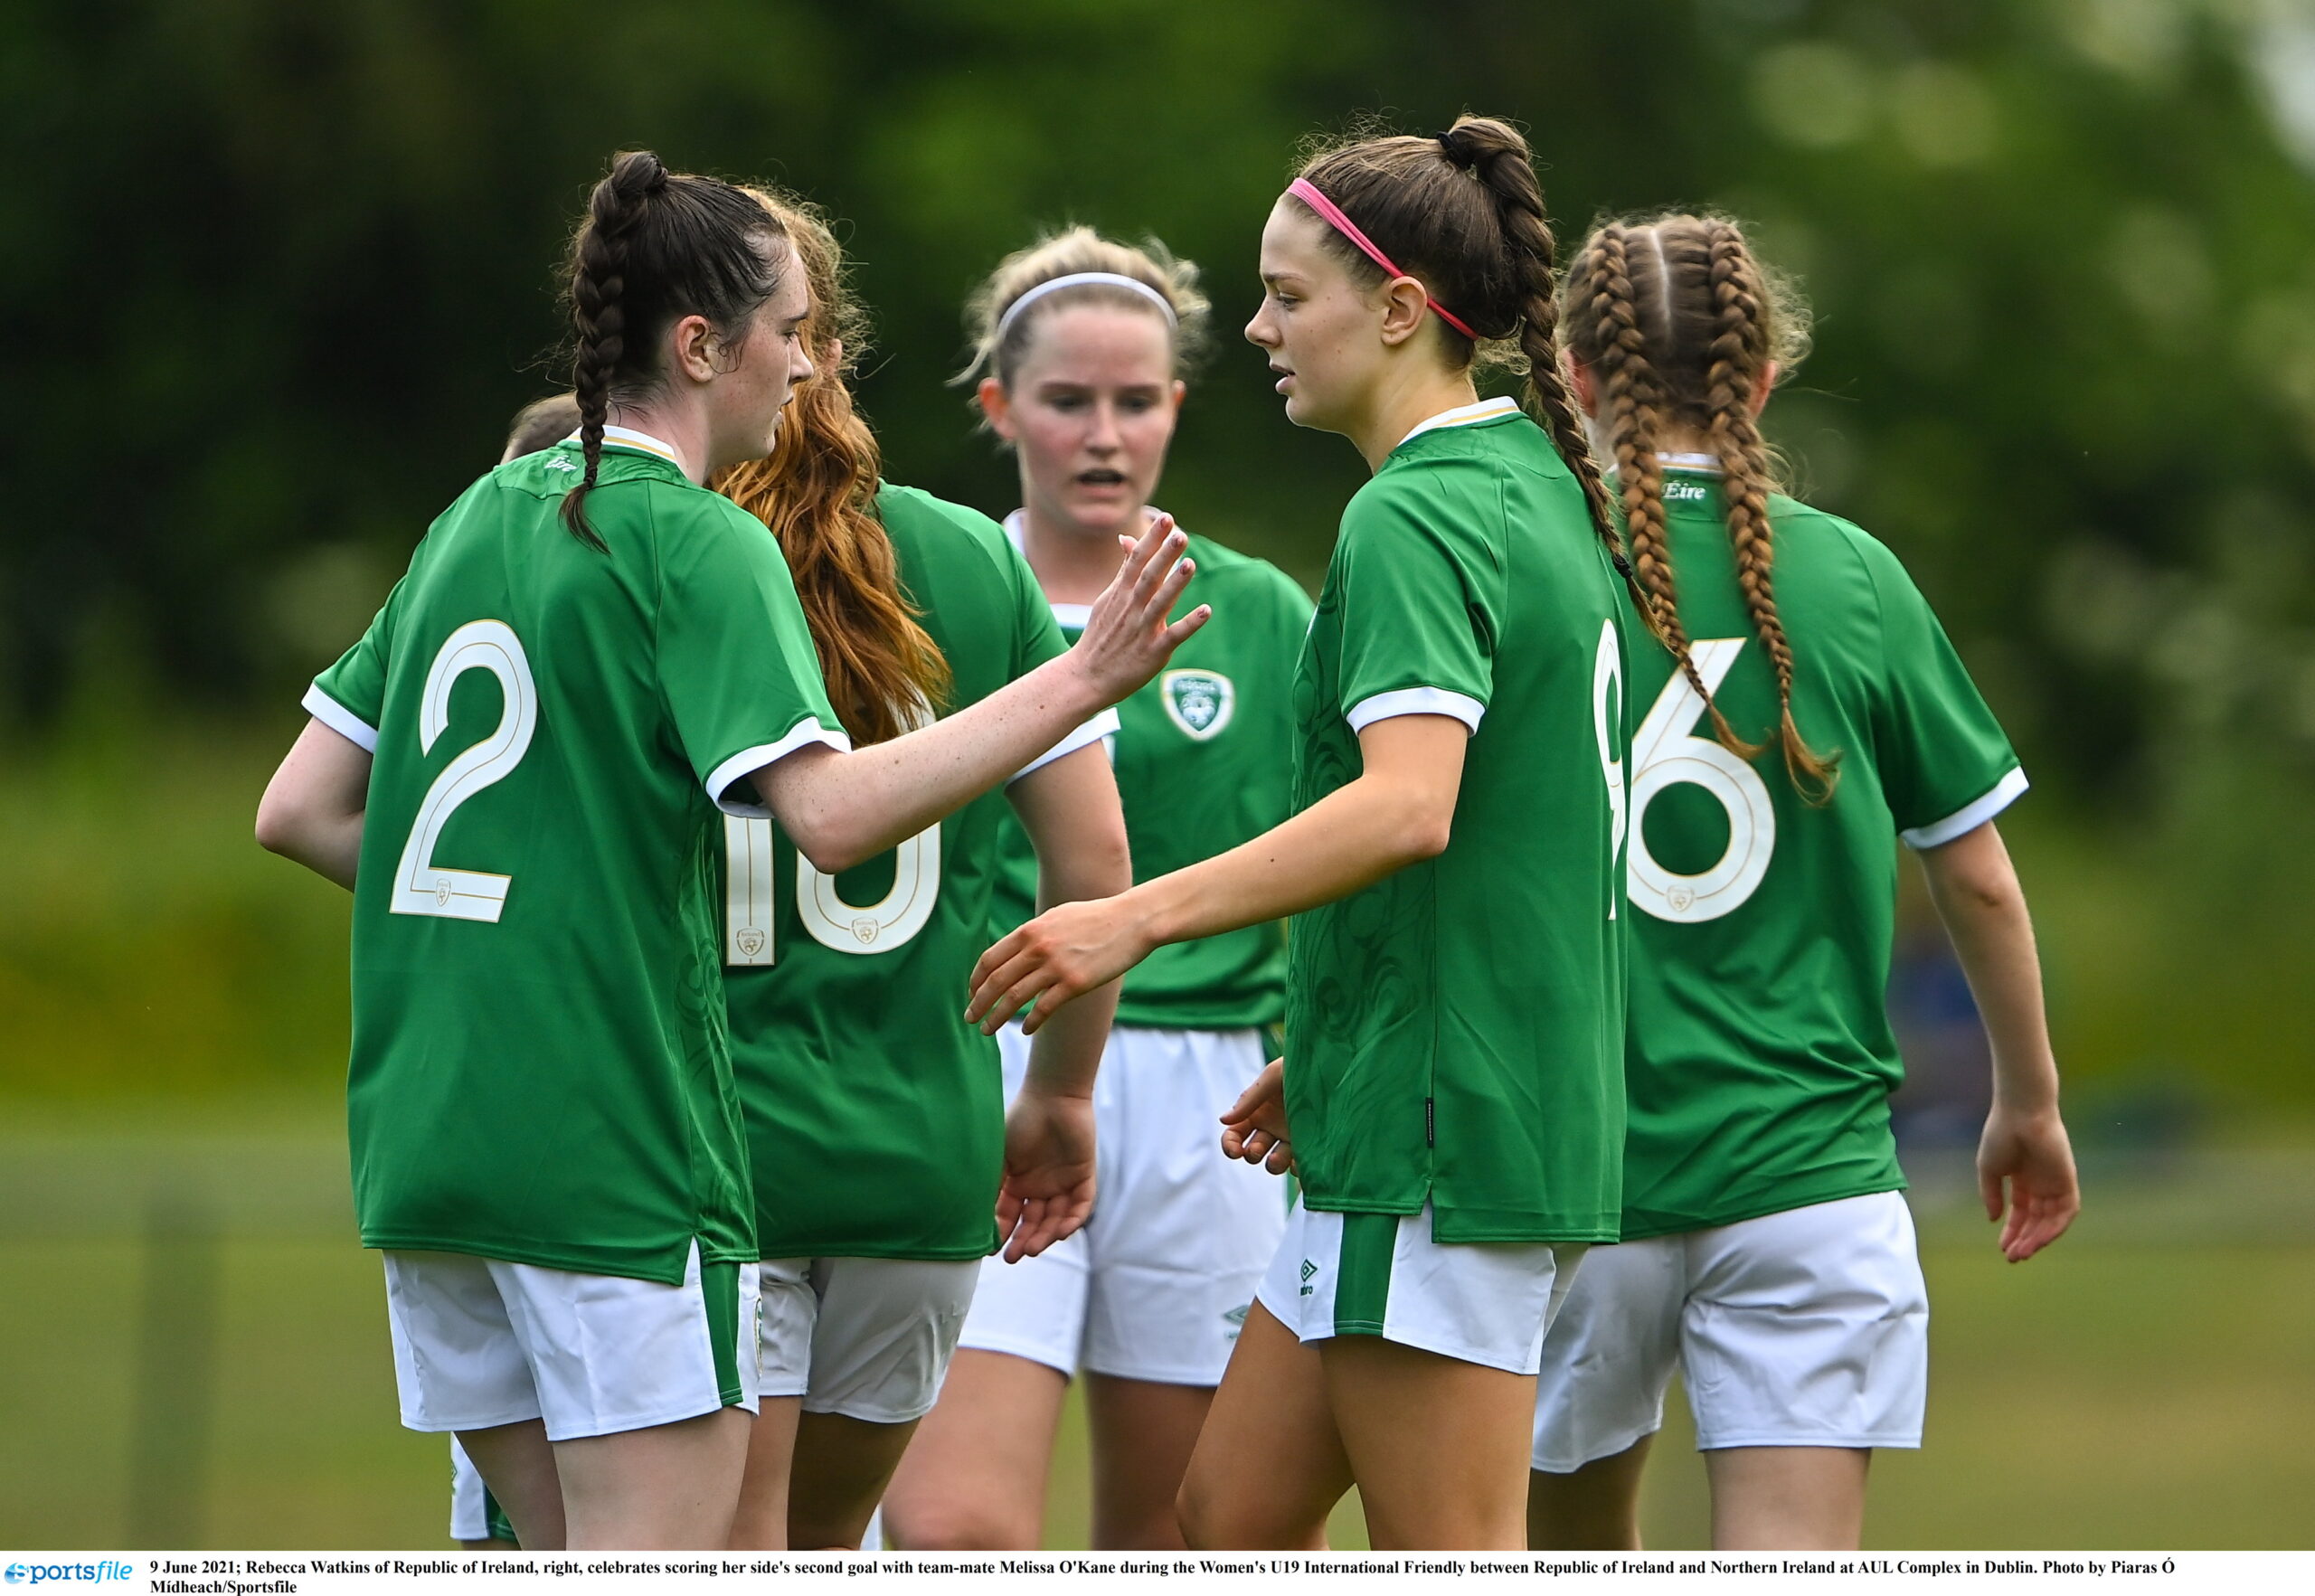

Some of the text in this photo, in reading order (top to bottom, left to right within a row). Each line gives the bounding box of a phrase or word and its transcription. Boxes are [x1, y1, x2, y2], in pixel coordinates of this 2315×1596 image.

[389, 619, 538, 923] 2
[1593, 618, 1627, 921] 9
[1627, 637, 1776, 923] 6
